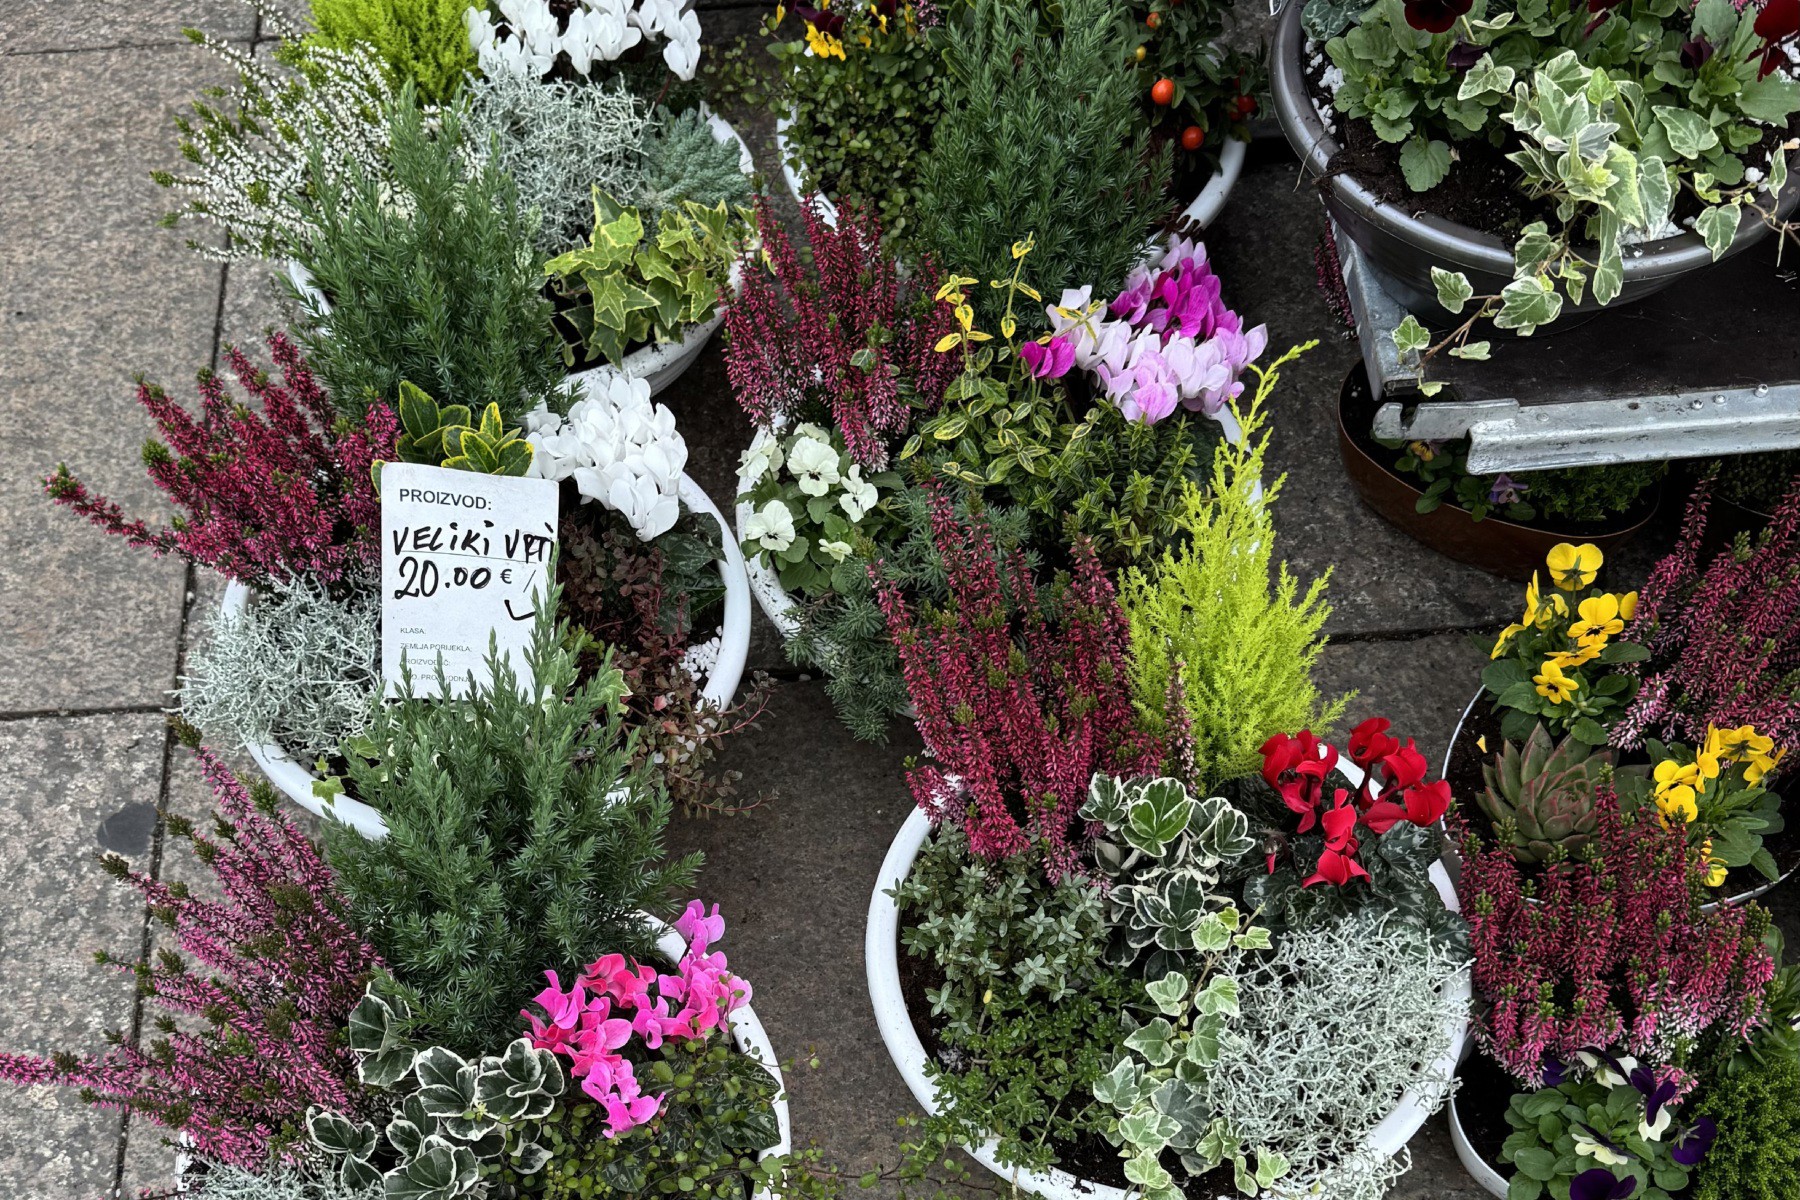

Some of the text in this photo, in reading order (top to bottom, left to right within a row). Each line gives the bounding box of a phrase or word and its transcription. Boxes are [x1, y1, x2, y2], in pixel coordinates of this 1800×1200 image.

[399, 488, 492, 511] PROIZVOD:
[394, 556, 492, 600] 20.00
[400, 642, 429, 650] ZEMLJA
